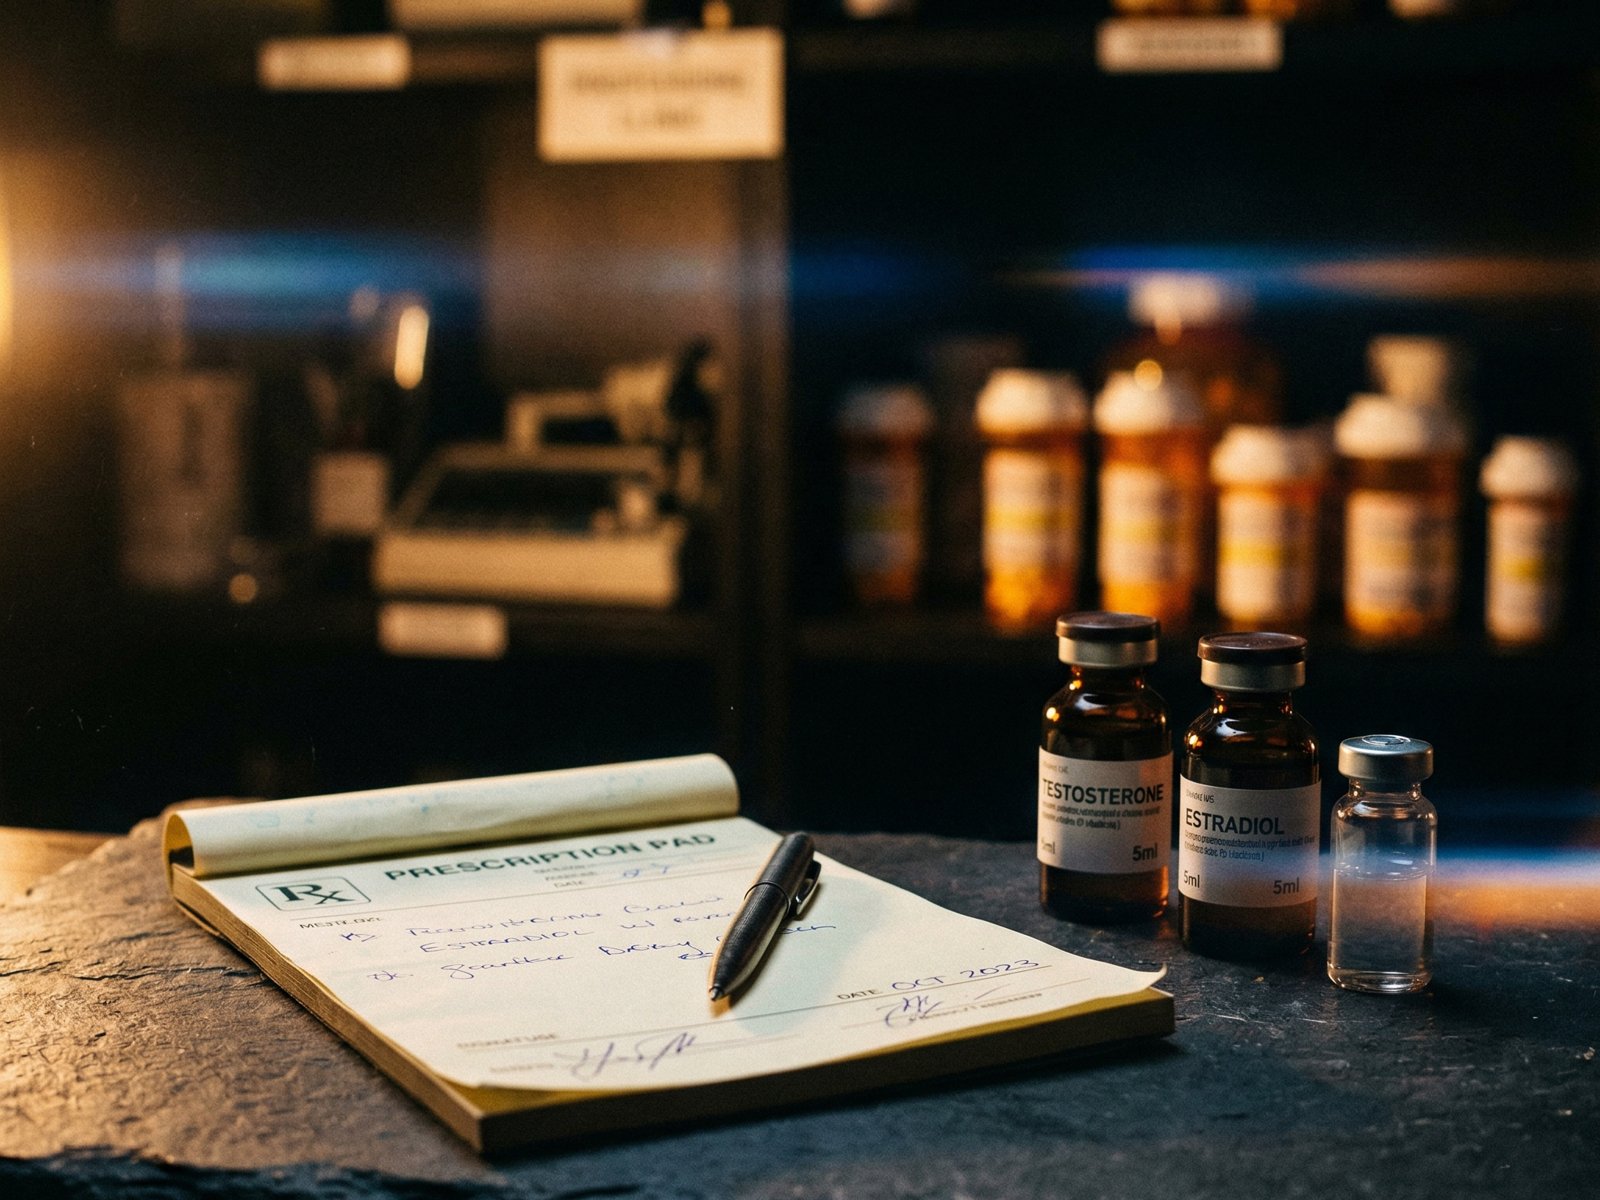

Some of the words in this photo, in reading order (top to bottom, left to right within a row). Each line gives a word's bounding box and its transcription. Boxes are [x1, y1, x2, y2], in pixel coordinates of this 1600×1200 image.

[1042, 778, 1164, 805] TESTOSTERONE
[1185, 807, 1285, 835] ESTRADIOL
[385, 842, 643, 882] PRESCRIPTION
[648, 833, 716, 850] PAD
[1132, 843, 1158, 861] 5ml
[1183, 870, 1200, 888] 5ml
[1273, 876, 1300, 895] 5ml
[892, 976, 946, 991] OCT
[960, 959, 1040, 979] 2023
[836, 988, 880, 1000] DATE
